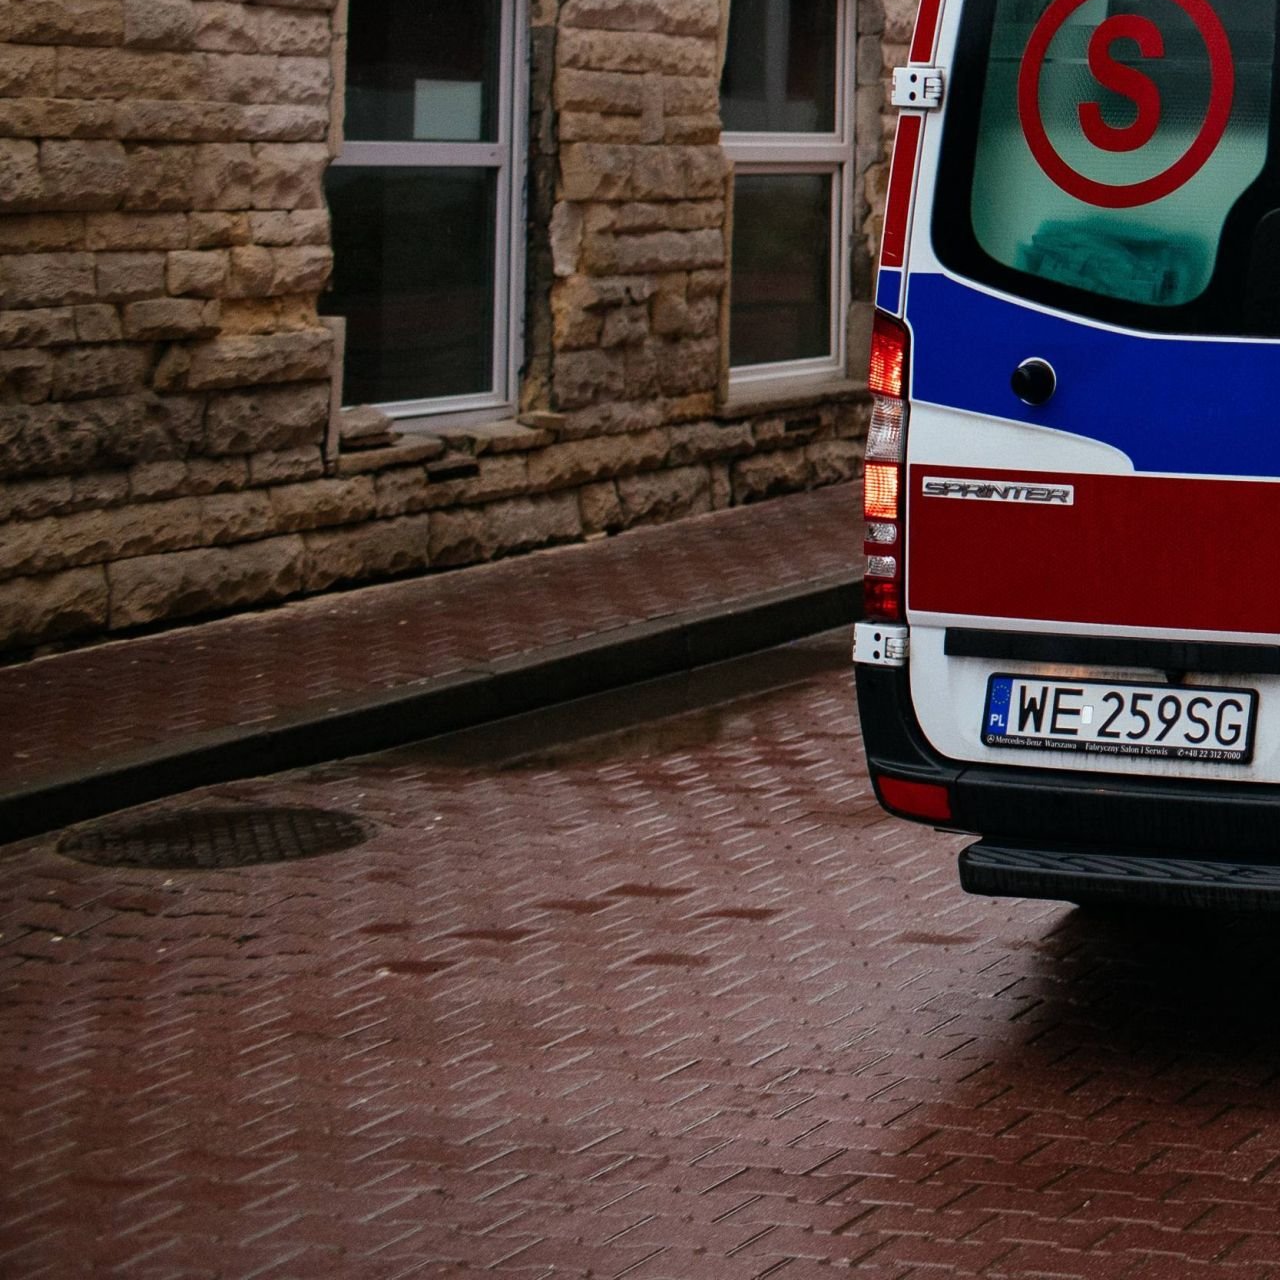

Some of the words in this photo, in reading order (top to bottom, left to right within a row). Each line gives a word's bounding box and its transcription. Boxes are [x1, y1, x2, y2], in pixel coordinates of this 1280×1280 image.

[1077, 13, 1165, 153] S
[922, 480, 1072, 504] SPRINTER
[990, 713, 1005, 727] PL
[1017, 685, 1084, 736] WE
[1096, 691, 1244, 746] 259SG
[995, 735, 1042, 747] Mercedes-Benz
[1045, 738, 1077, 750] Warszawa
[1085, 742, 1120, 754] Fabryczny
[1120, 745, 1140, 754] Salon
[1145, 746, 1168, 756] Serwis
[1198, 750, 1208, 758] 22
[1210, 751, 1222, 759] 312
[1223, 751, 1241, 760] 7000
